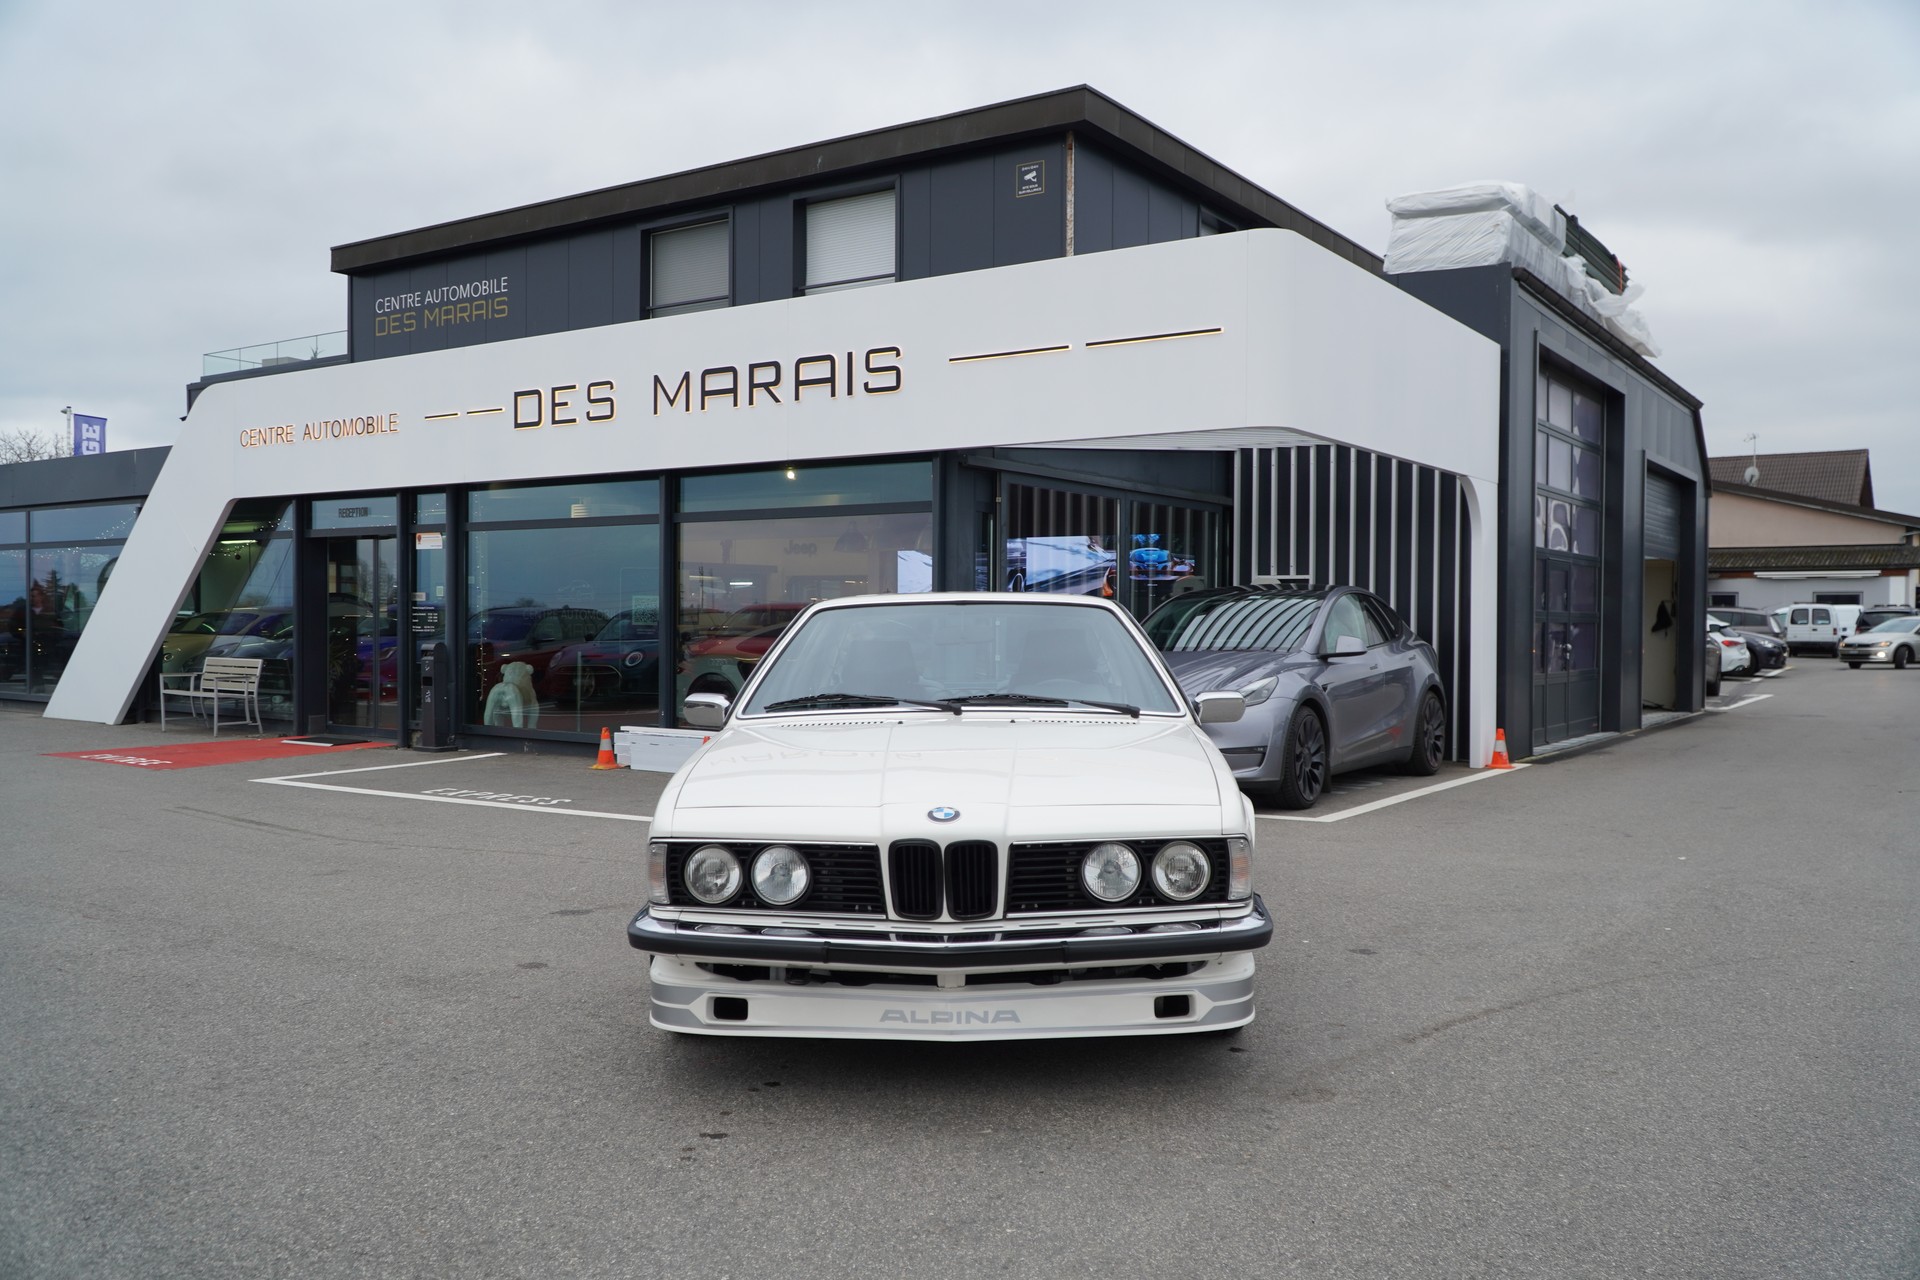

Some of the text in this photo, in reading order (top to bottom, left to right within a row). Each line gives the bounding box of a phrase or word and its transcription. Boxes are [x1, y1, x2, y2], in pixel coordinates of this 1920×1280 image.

[375, 276, 509, 314] CENTRE AUTOMOBILE
[375, 296, 509, 336] DES MARAIS
[513, 345, 903, 430] DES MARAIS
[239, 412, 400, 448] CENTRE AUTOMOBILE
[784, 539, 817, 558] Jeep
[420, 787, 573, 805] EXPRESS
[879, 1009, 1022, 1025] ALPINA
